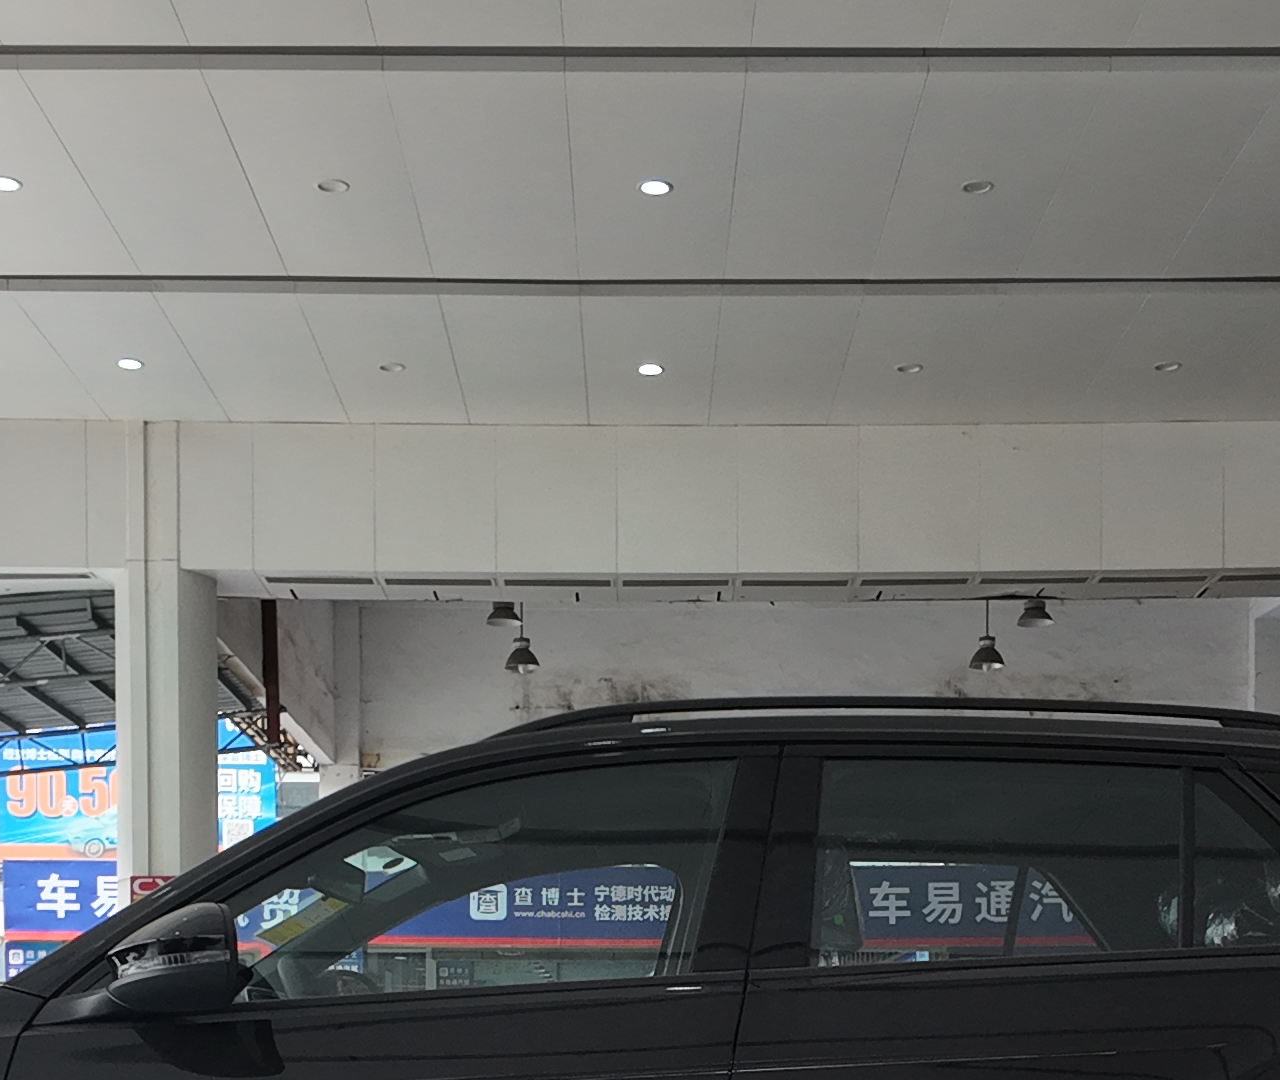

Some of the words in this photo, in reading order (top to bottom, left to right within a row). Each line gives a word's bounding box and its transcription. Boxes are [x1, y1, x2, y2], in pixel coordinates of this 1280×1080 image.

[514, 887, 586, 906] 查博士
[594, 885, 675, 902] 宁德时代动
[869, 881, 1074, 925] 车易通汽
